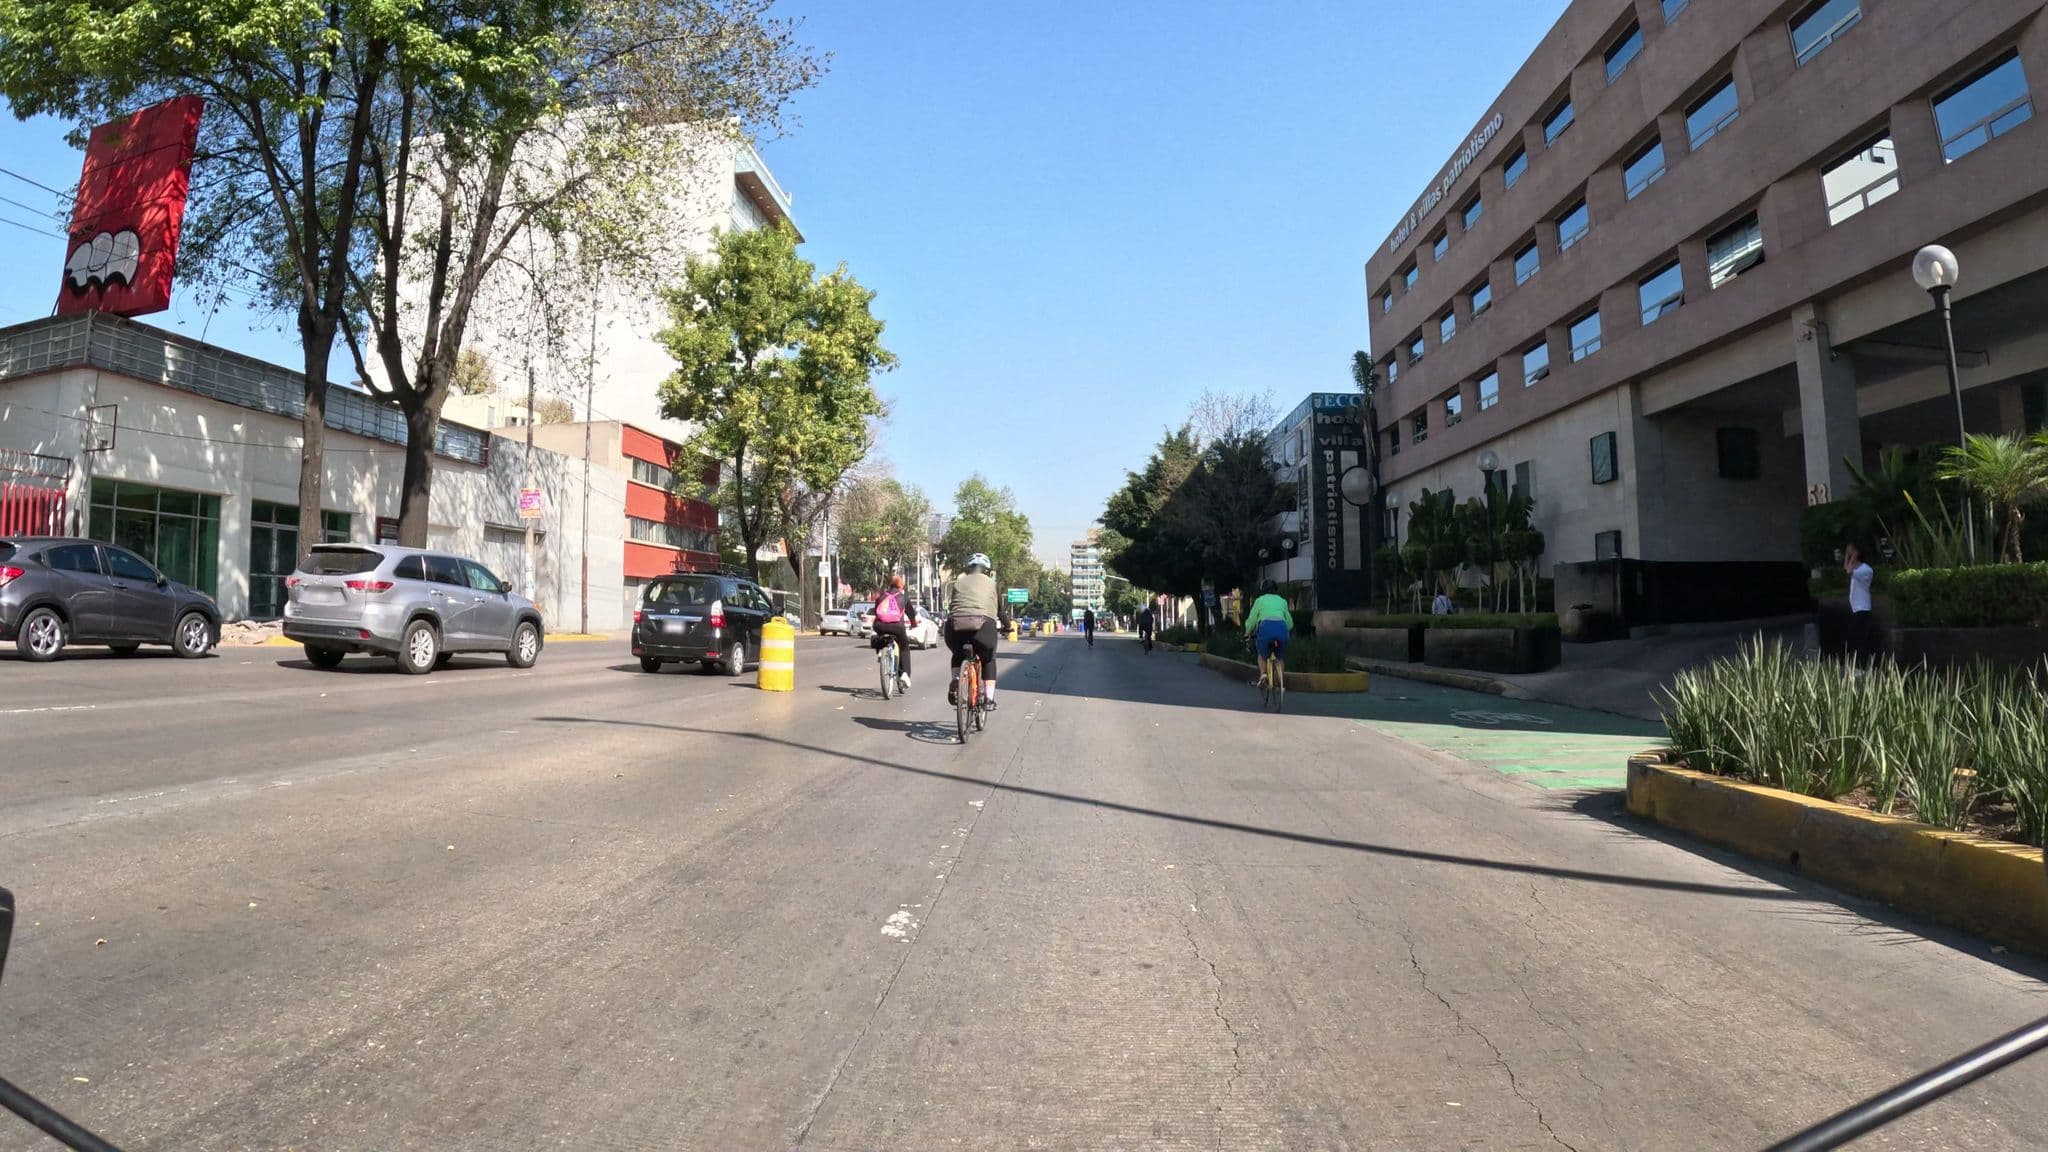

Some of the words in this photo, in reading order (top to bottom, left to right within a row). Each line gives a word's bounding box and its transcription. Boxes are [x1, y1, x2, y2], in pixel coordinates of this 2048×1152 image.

[1390, 220, 1410, 254] hotel
[1418, 186, 1442, 220] villas
[1443, 112, 1504, 198] patriotismo
[1323, 449, 1338, 569] patriotismo
